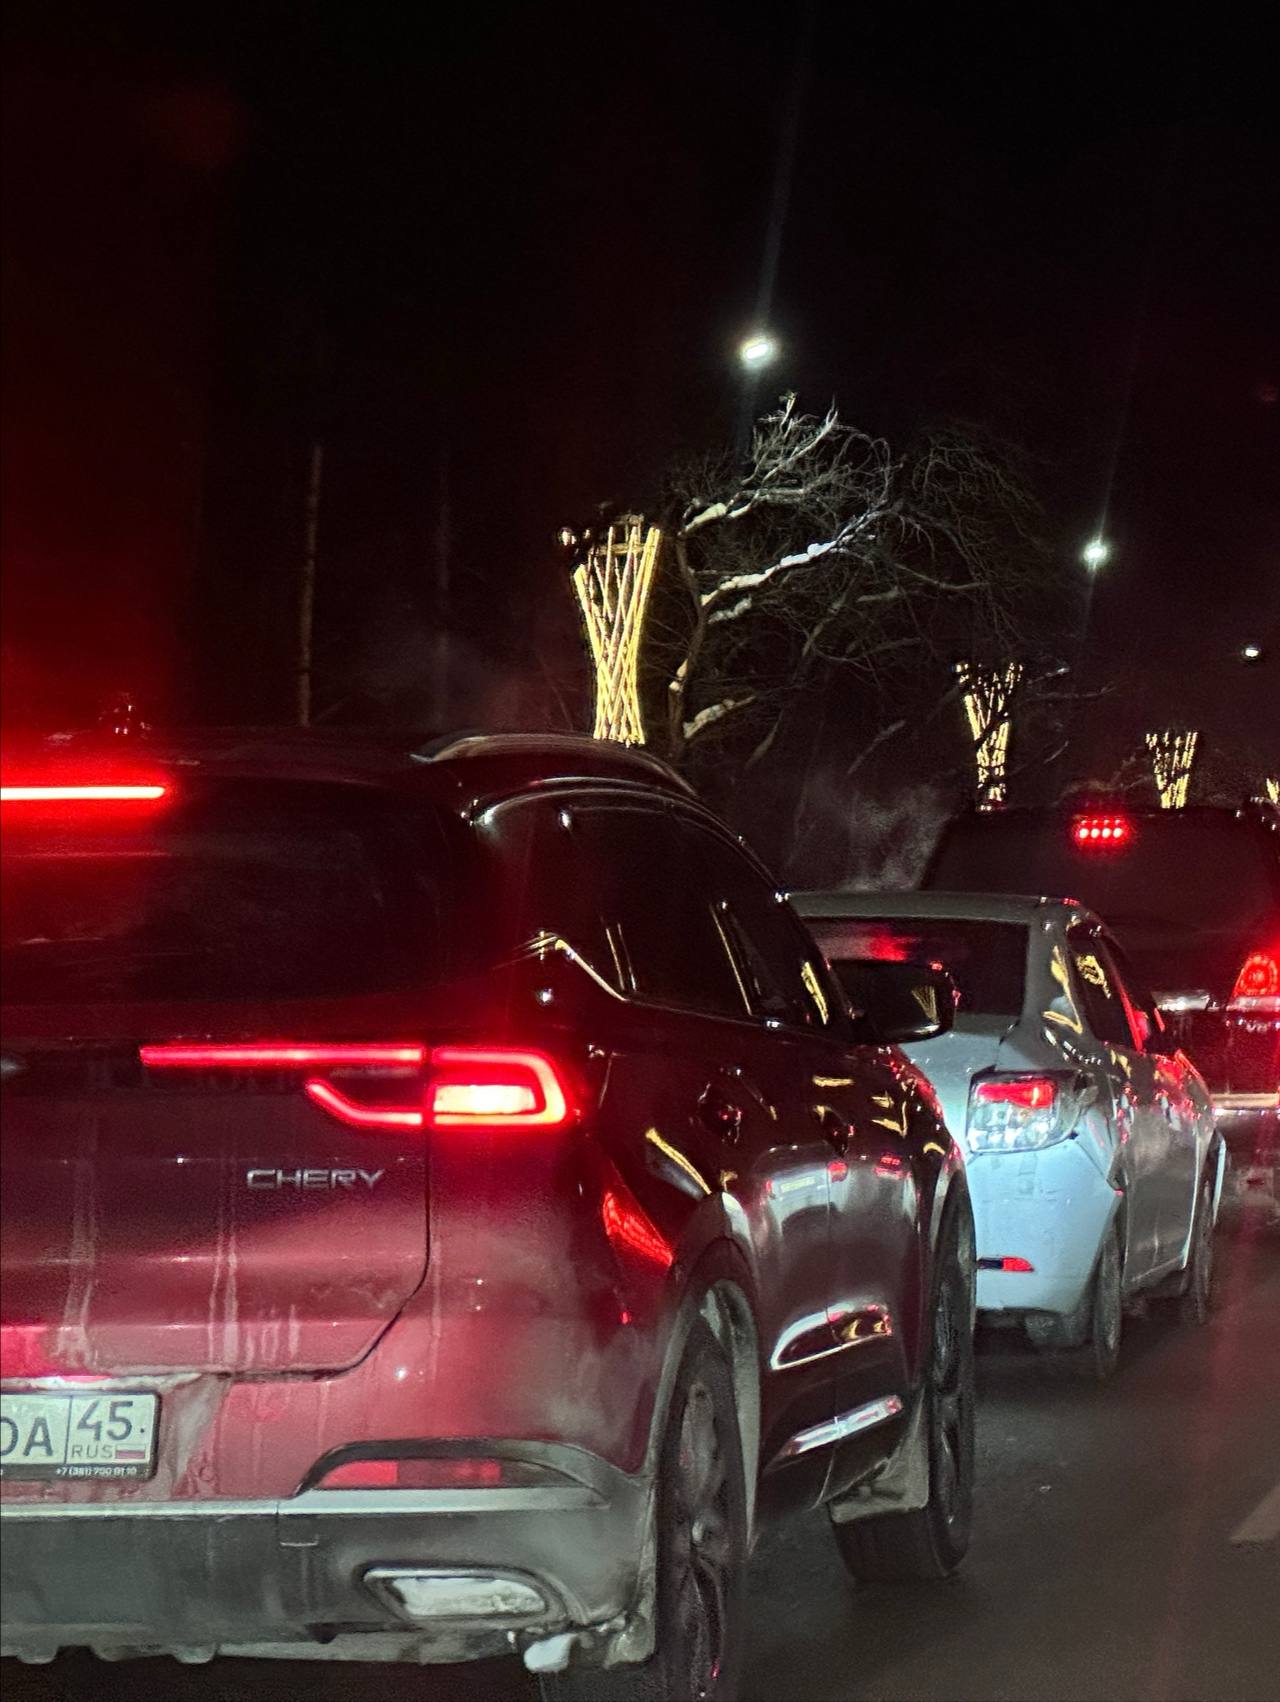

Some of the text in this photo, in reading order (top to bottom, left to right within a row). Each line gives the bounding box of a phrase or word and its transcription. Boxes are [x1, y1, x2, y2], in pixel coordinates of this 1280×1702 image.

[247, 1168, 386, 1190] CHERY
[77, 1400, 134, 1442] 45
[71, 1444, 113, 1460] RUS
